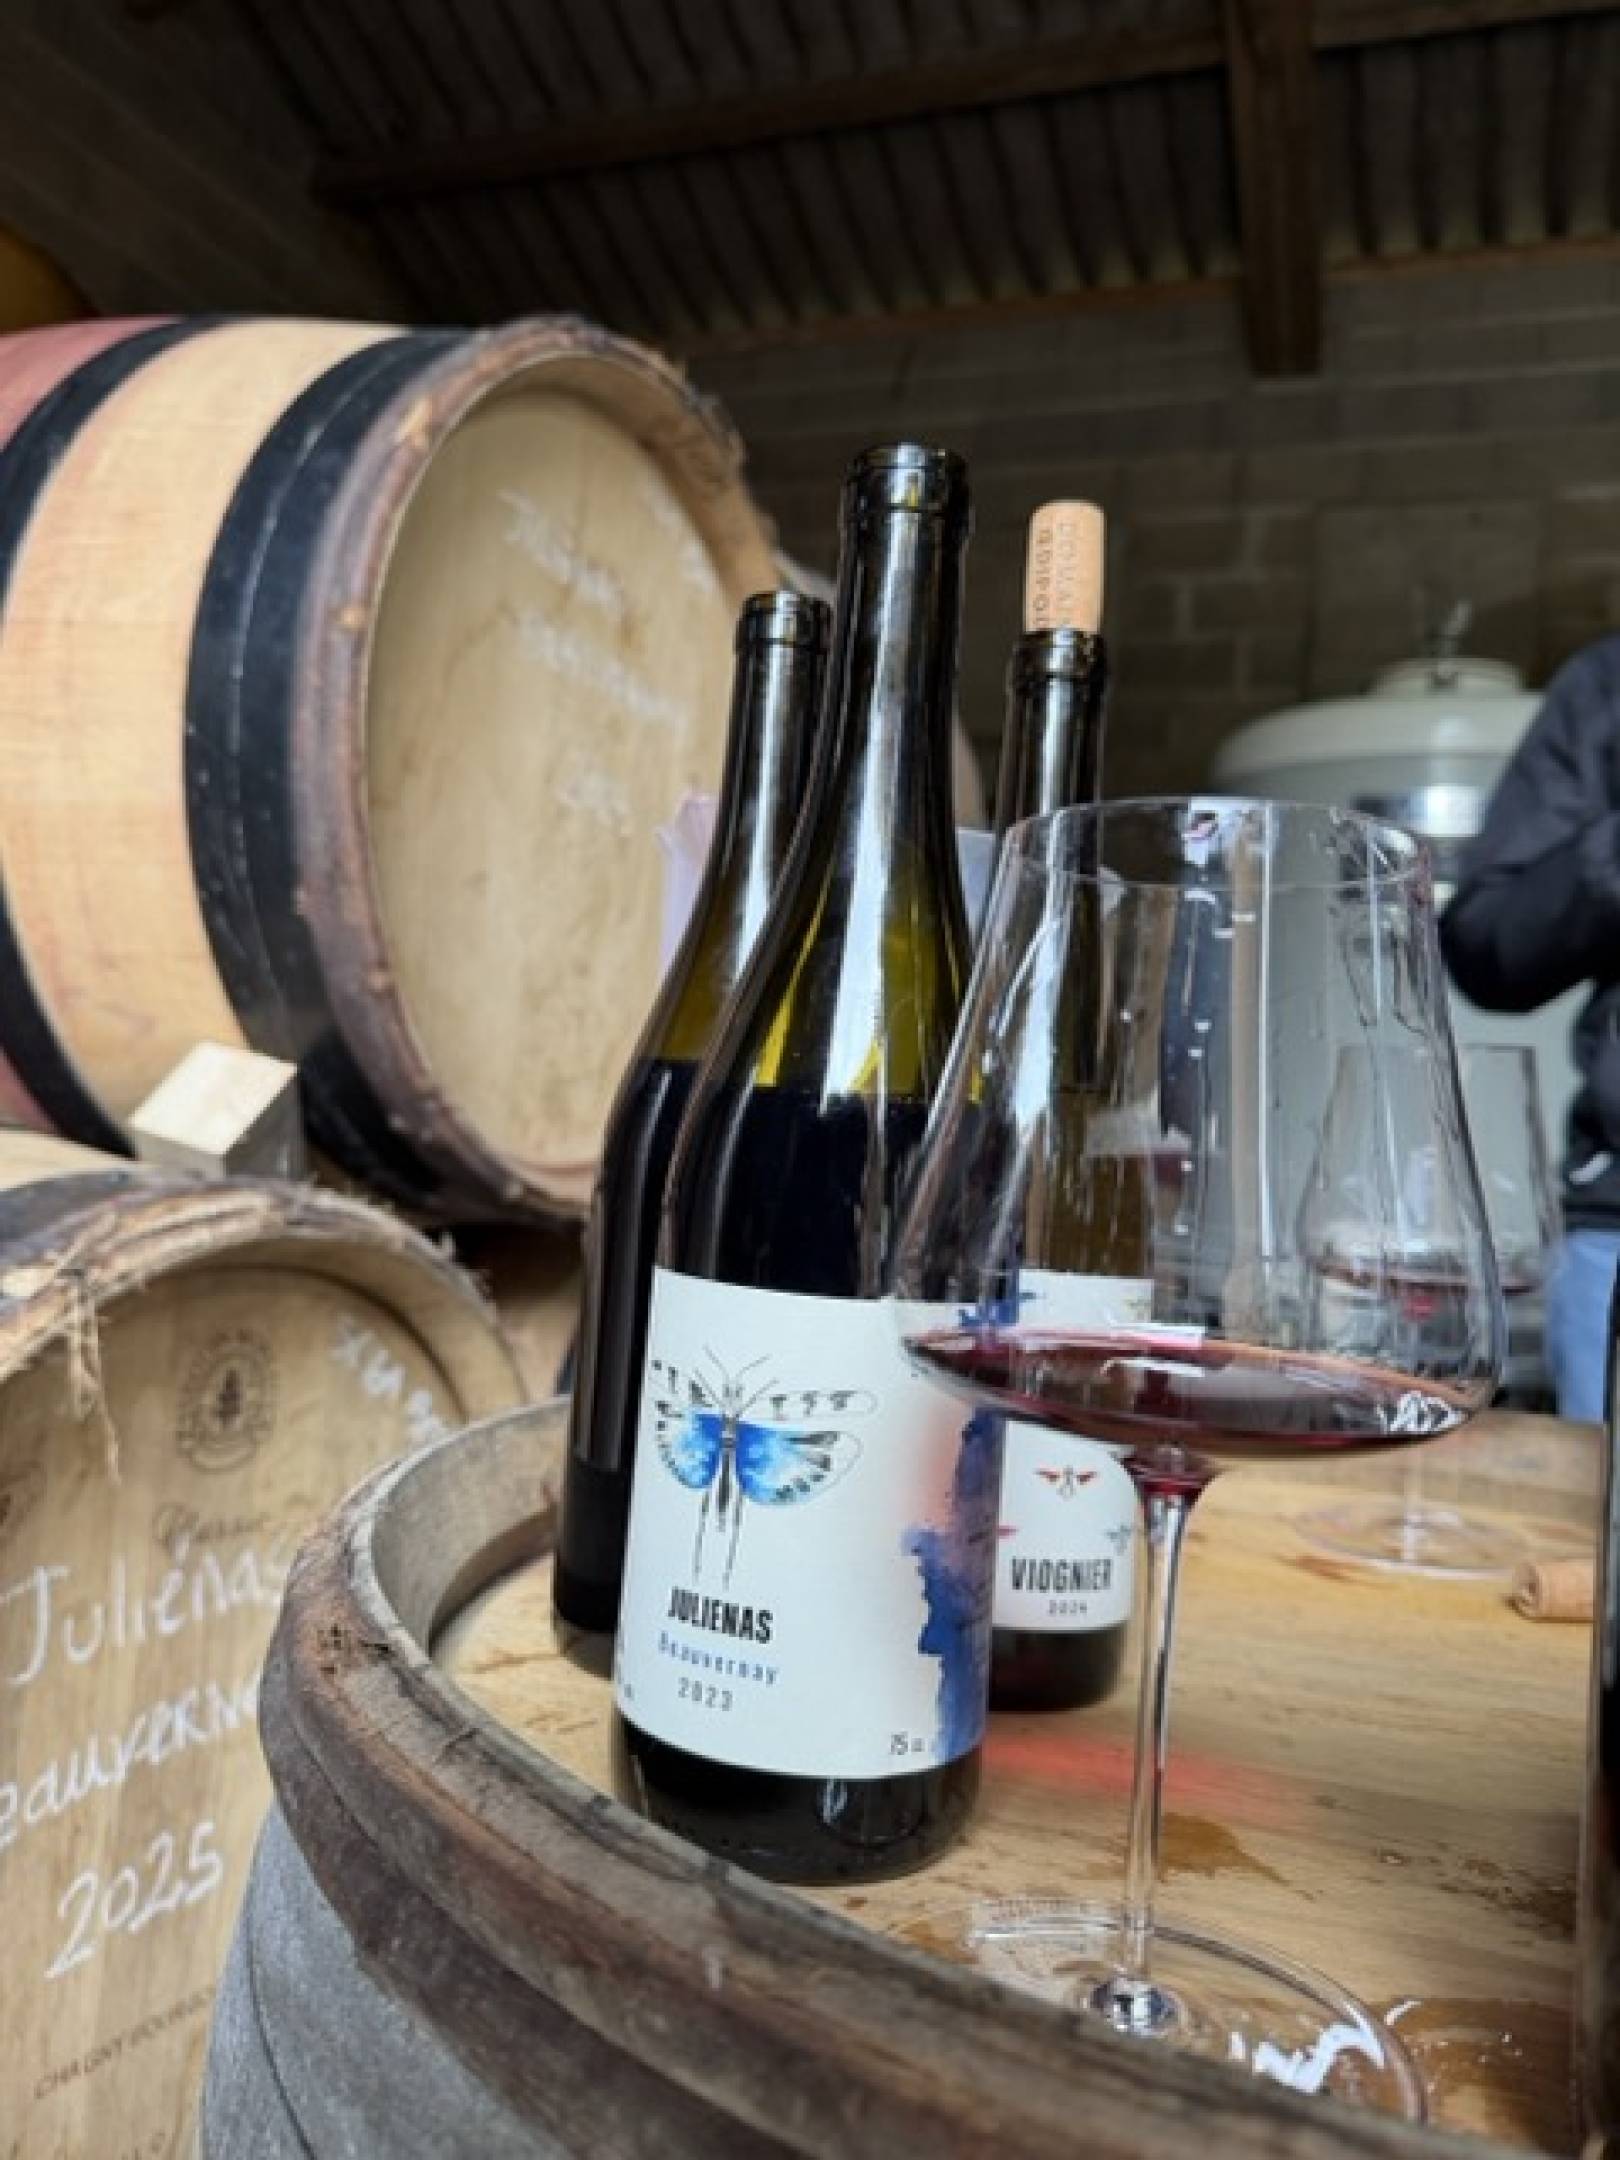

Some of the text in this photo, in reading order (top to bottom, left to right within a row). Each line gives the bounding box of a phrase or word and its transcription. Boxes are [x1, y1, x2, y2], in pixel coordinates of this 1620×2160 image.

[1011, 1556, 1112, 1593] VIOGNIER
[668, 1586, 773, 1645] JULIENAS
[678, 1676, 733, 1712] 2023
[889, 1731, 909, 1755] 75
[44, 1821, 223, 1980] 2025
